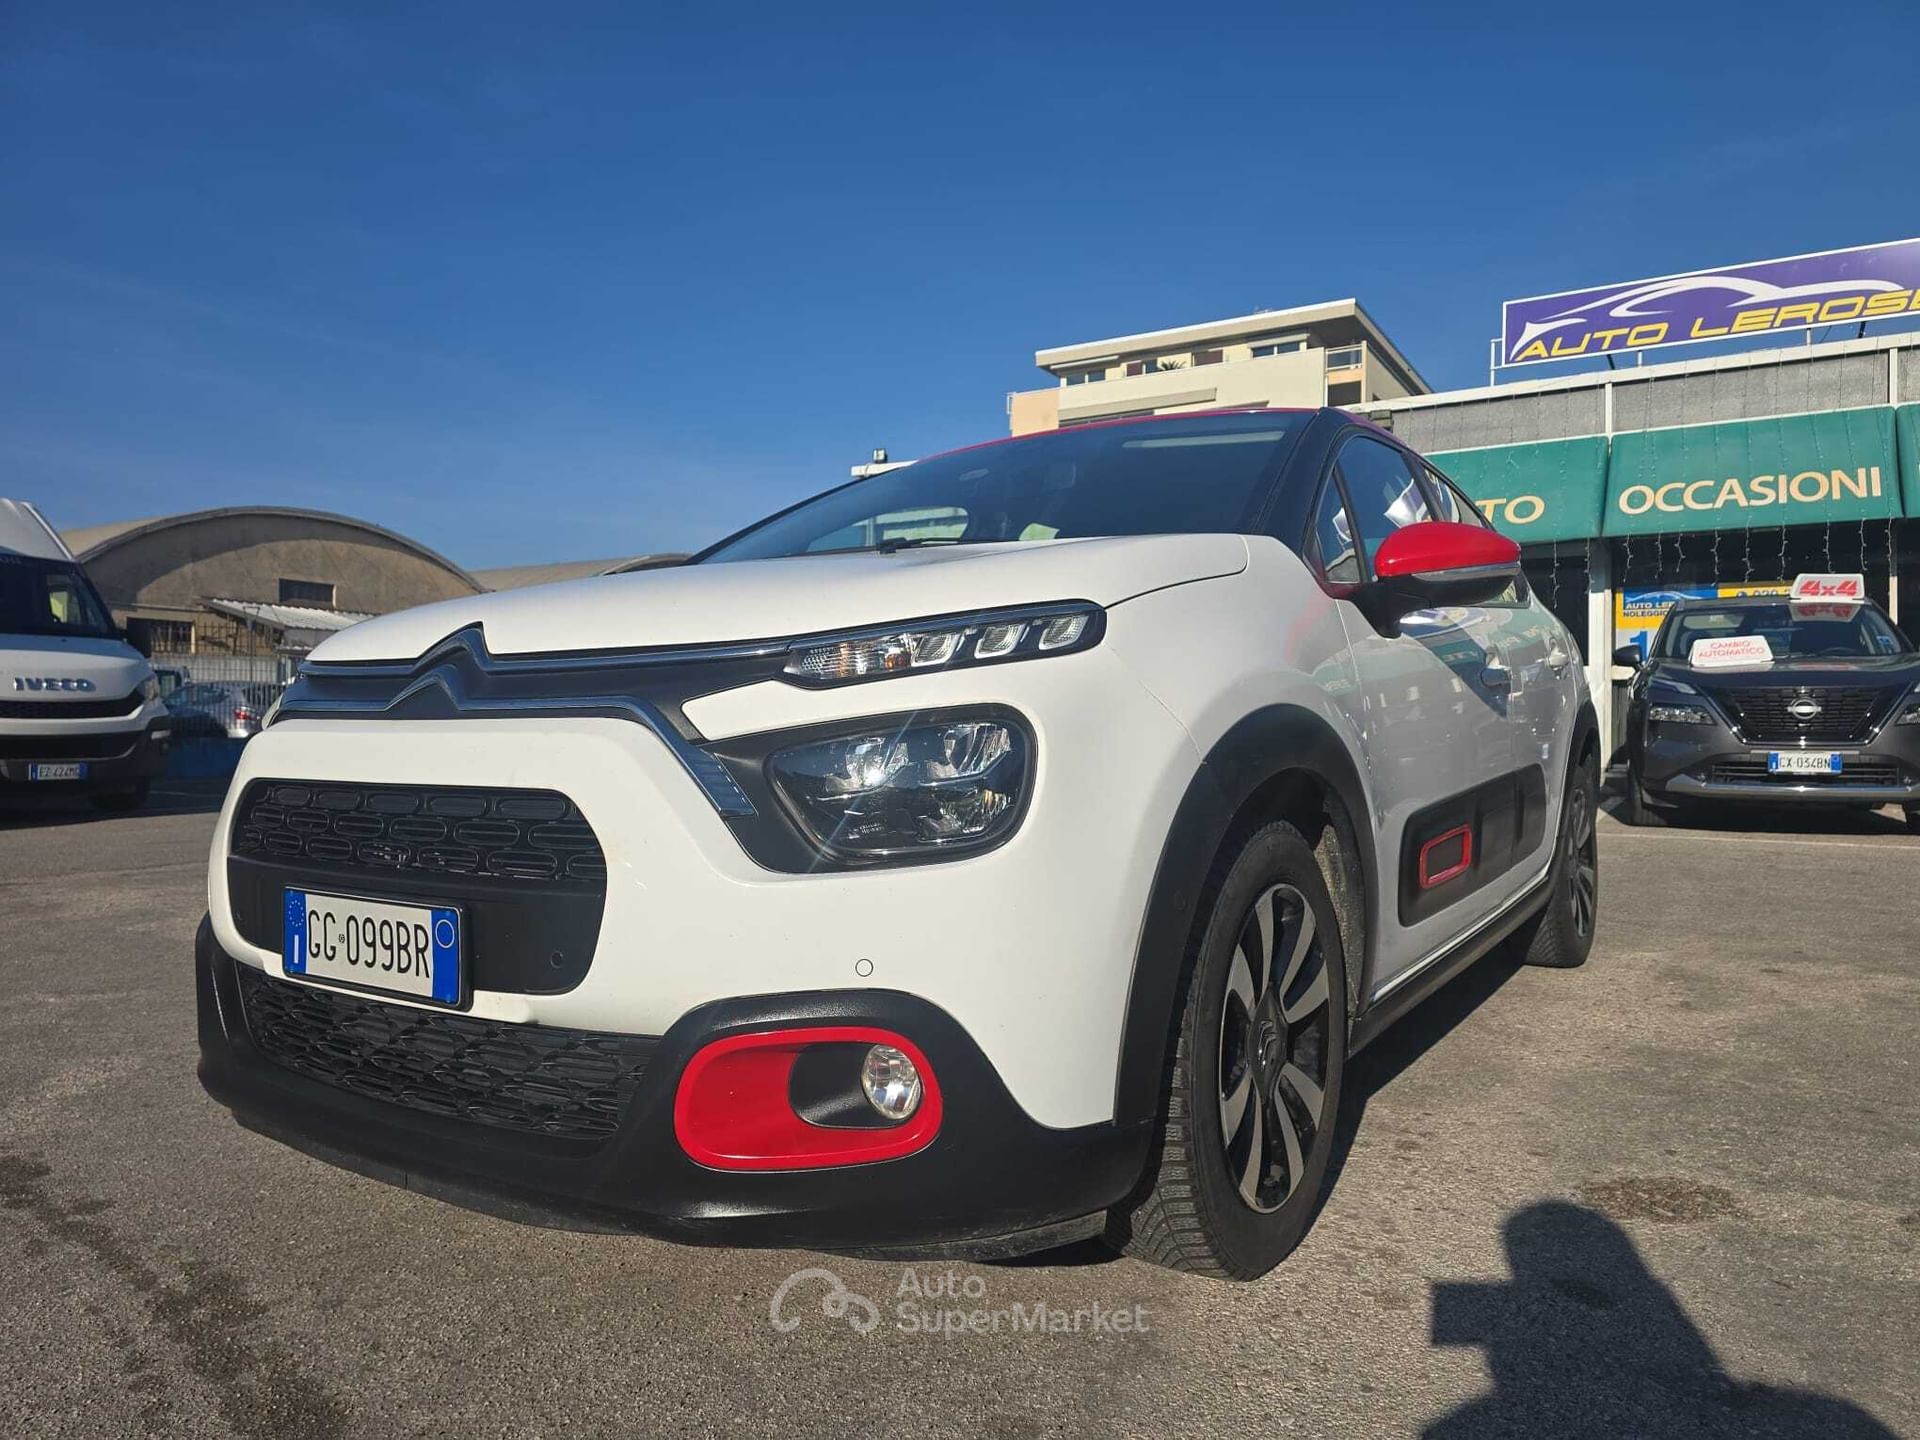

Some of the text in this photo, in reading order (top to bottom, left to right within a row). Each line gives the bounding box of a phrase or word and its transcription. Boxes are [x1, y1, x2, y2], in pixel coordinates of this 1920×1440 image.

[1515, 322, 1669, 362] AUTO
[1618, 466, 1881, 515] OCCASIONI
[1799, 580, 1858, 596] 4x4
[1698, 646, 1767, 658] AUTOMATICO
[1710, 639, 1752, 650] CAMBIO
[13, 677, 96, 692] IVECO
[346, 915, 429, 978] 099BR
